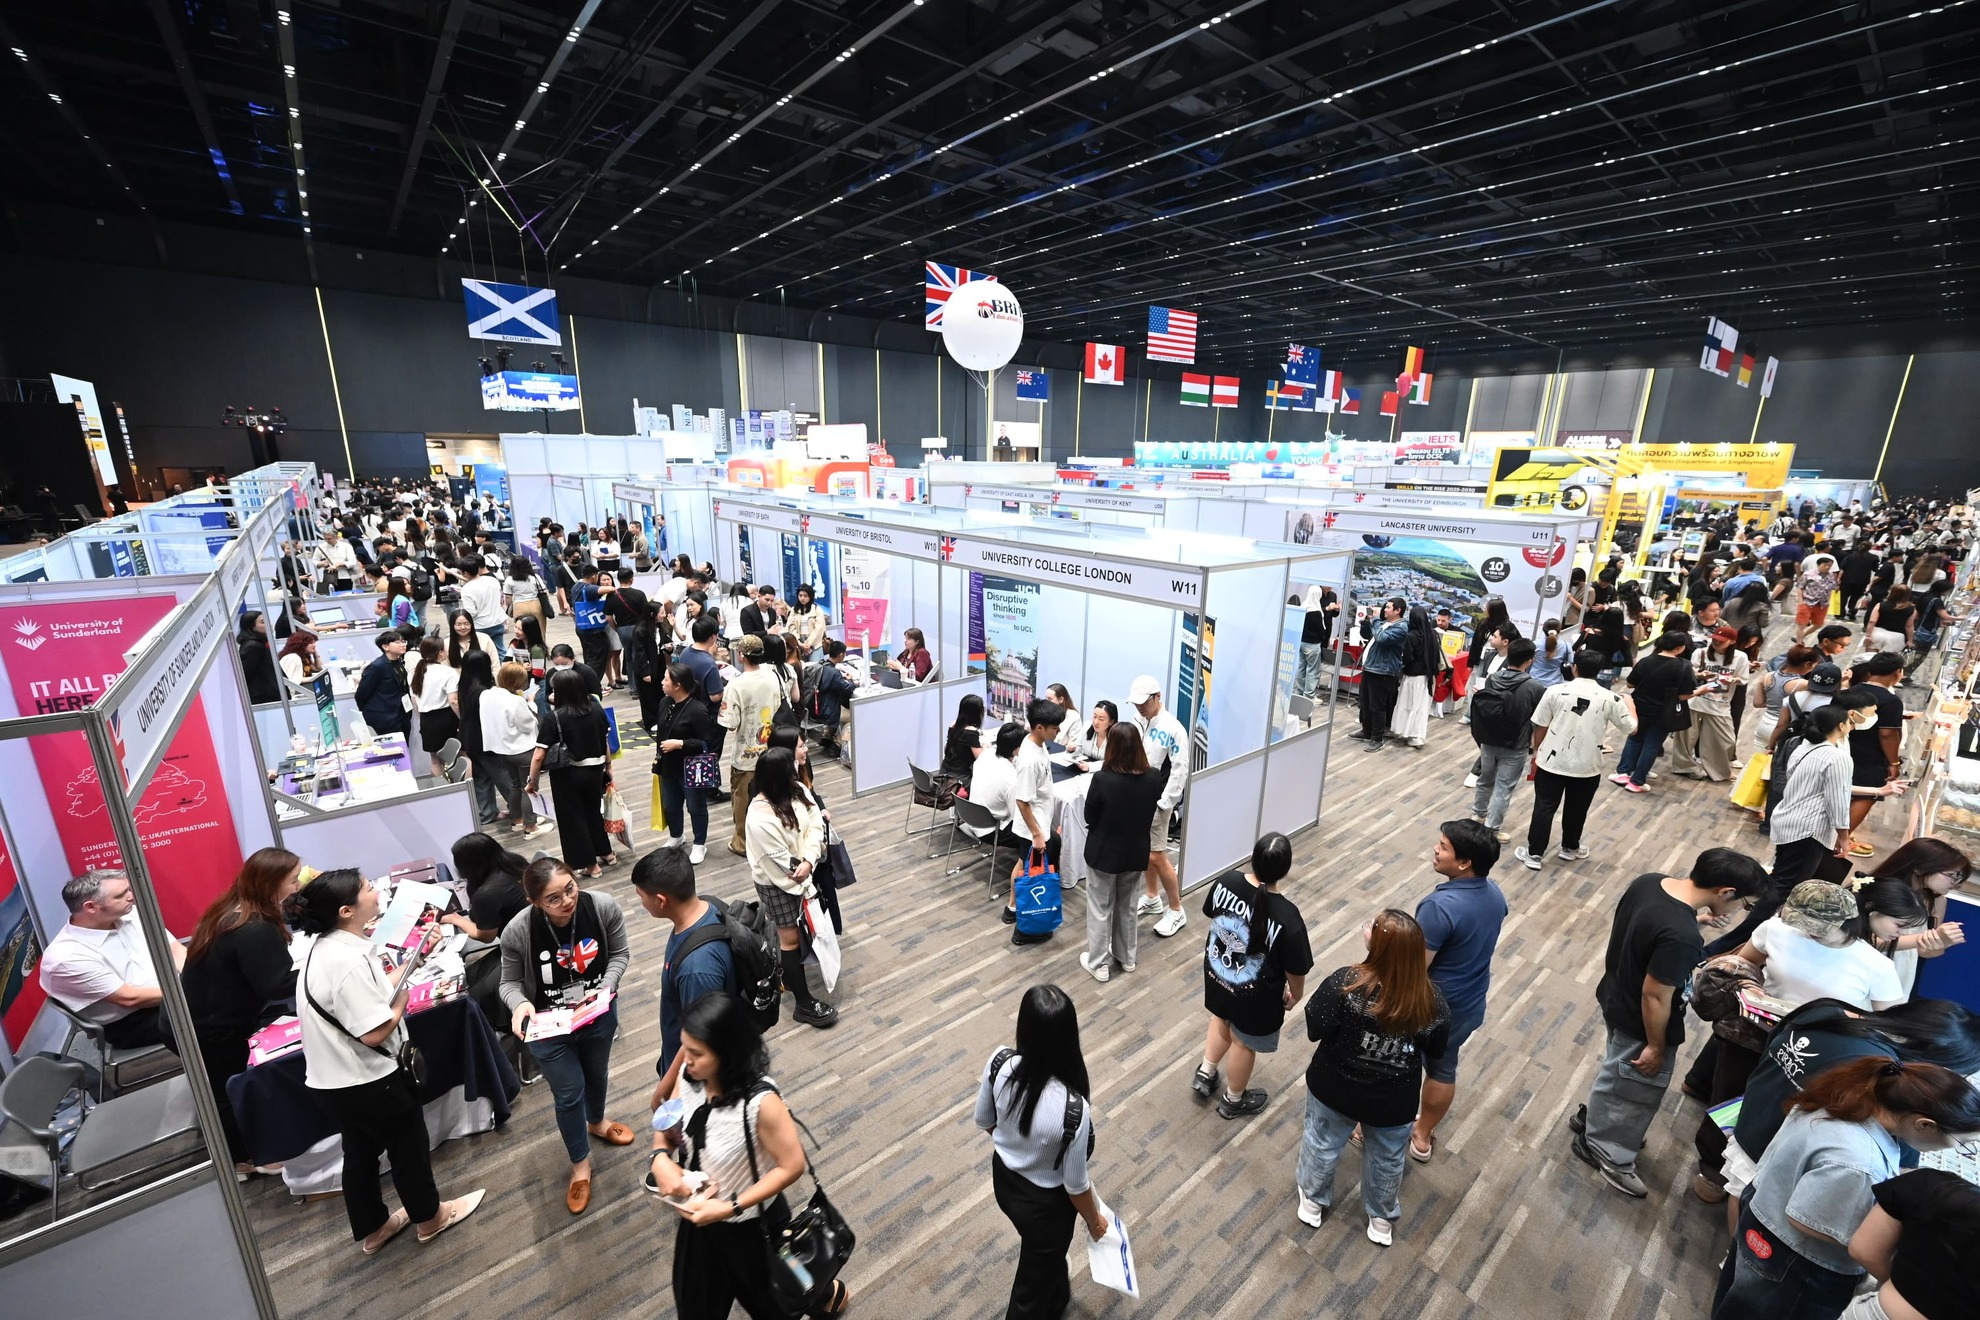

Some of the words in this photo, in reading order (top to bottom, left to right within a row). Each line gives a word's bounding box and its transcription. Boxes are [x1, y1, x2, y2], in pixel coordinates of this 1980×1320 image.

[502, 335, 532, 343] SCOTLAND
[1428, 435, 1456, 444] IELTS
[1171, 449, 1255, 461] AUSTRALIA
[1290, 455, 1323, 465] YOUNG
[738, 509, 756, 519] UNIVERSITY
[761, 513, 770, 521] BATH
[1380, 521, 1426, 531] LANCASTER
[1427, 524, 1477, 535] UNIVERSITY
[1532, 531, 1549, 540] U11
[835, 526, 861, 538] UNIVERSITY
[862, 531, 869, 539] OF
[870, 532, 892, 544] BRISTOL
[924, 541, 937, 552] W10
[1488, 560, 1504, 571] 10
[981, 550, 1033, 568] UNIVERSITY
[1035, 557, 1081, 577] COLLEGE
[1084, 565, 1132, 585] LONDON
[1171, 579, 1198, 596] W11
[859, 581, 871, 591] 10
[986, 591, 1029, 605] Disruptive
[993, 603, 1027, 617] thinking
[50, 619, 109, 631] University
[111, 617, 124, 626] of
[1020, 625, 1033, 634] UCL
[52, 627, 121, 639] Sunderland
[136, 673, 172, 733] UNIVERSITY
[168, 662, 178, 688] OF
[174, 626, 202, 678] SUNDERLAND
[201, 609, 216, 634] LONDON
[29, 680, 51, 698] IT
[59, 676, 100, 695] ALL
[1149, 727, 1180, 757] asics
[84, 852, 101, 862] +44
[150, 839, 171, 849] 3000
[1211, 945, 1245, 975] BOY
